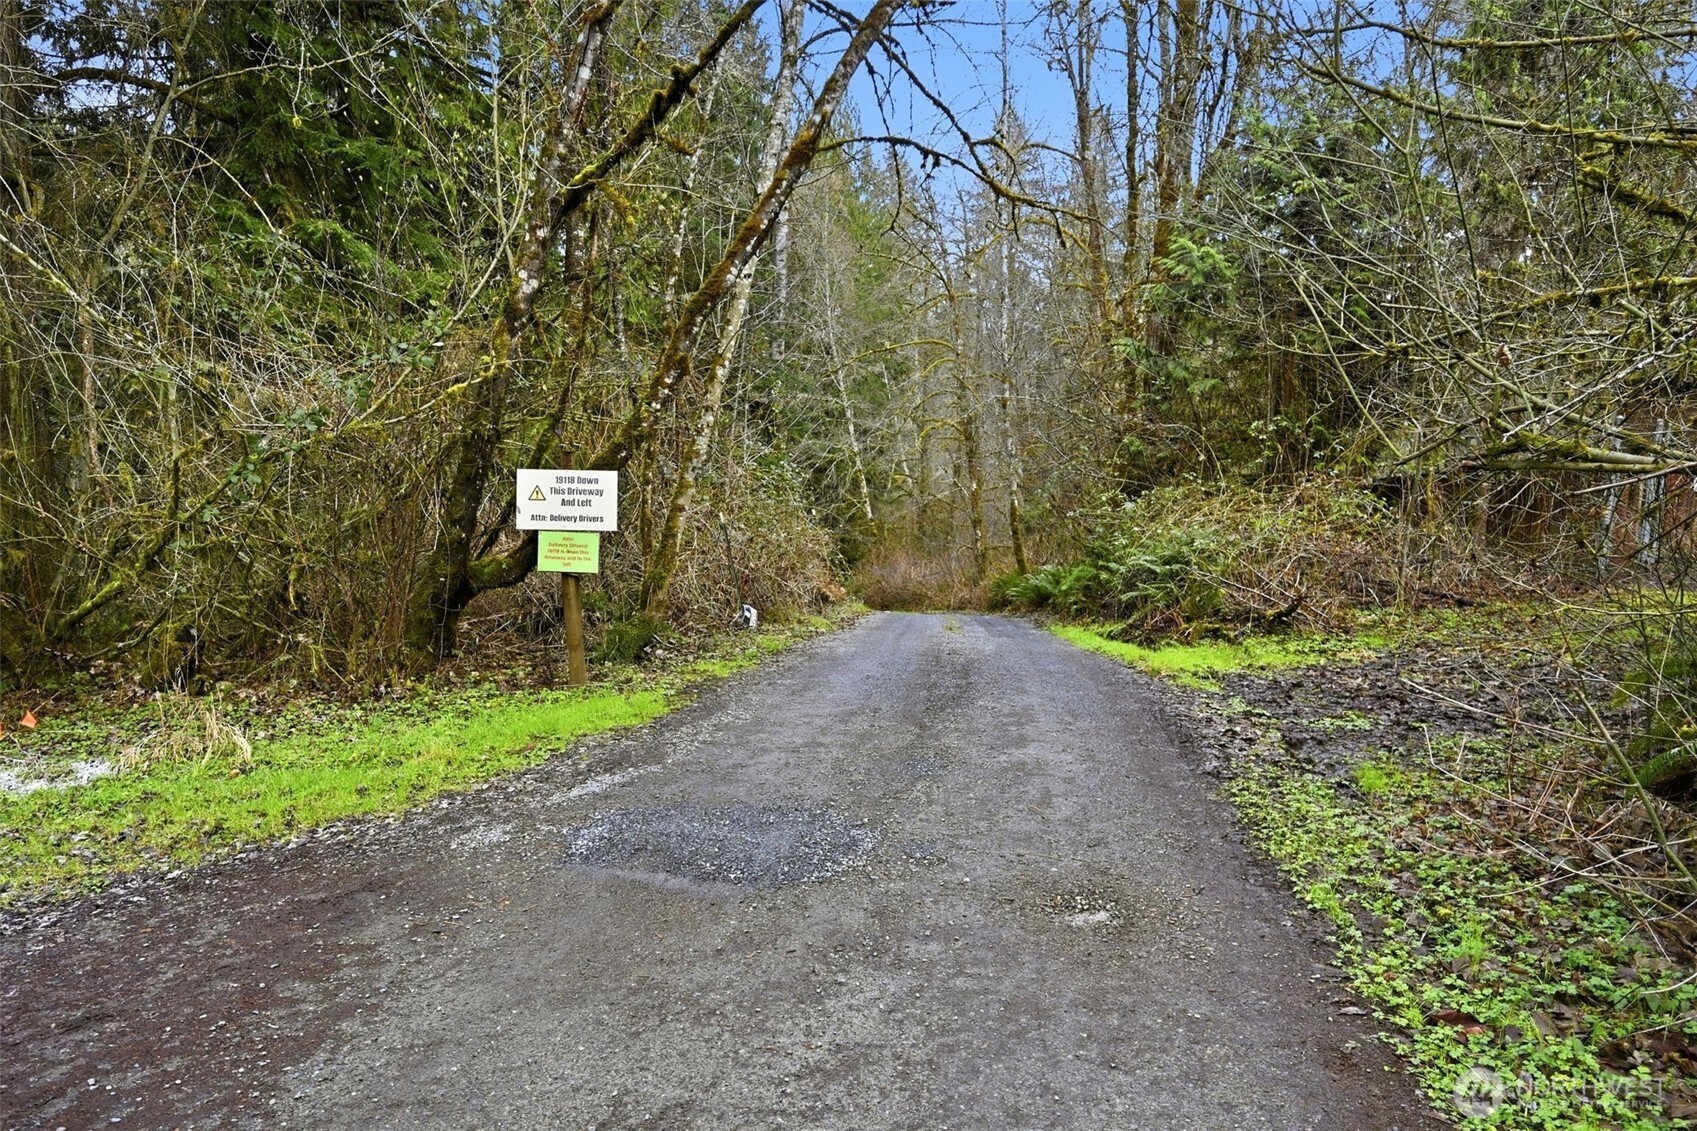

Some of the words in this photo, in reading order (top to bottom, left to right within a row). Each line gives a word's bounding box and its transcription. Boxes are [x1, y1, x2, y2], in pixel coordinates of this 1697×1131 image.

[555, 476, 575, 484] 19118
[577, 476, 599, 485] Down
[549, 487, 566, 495] This
[567, 487, 604, 497] Driveway
[560, 498, 576, 507] And
[577, 498, 592, 507] Left
[530, 514, 548, 522] Attn:
[549, 514, 578, 523] Delivery
[579, 515, 604, 523] Drivers
